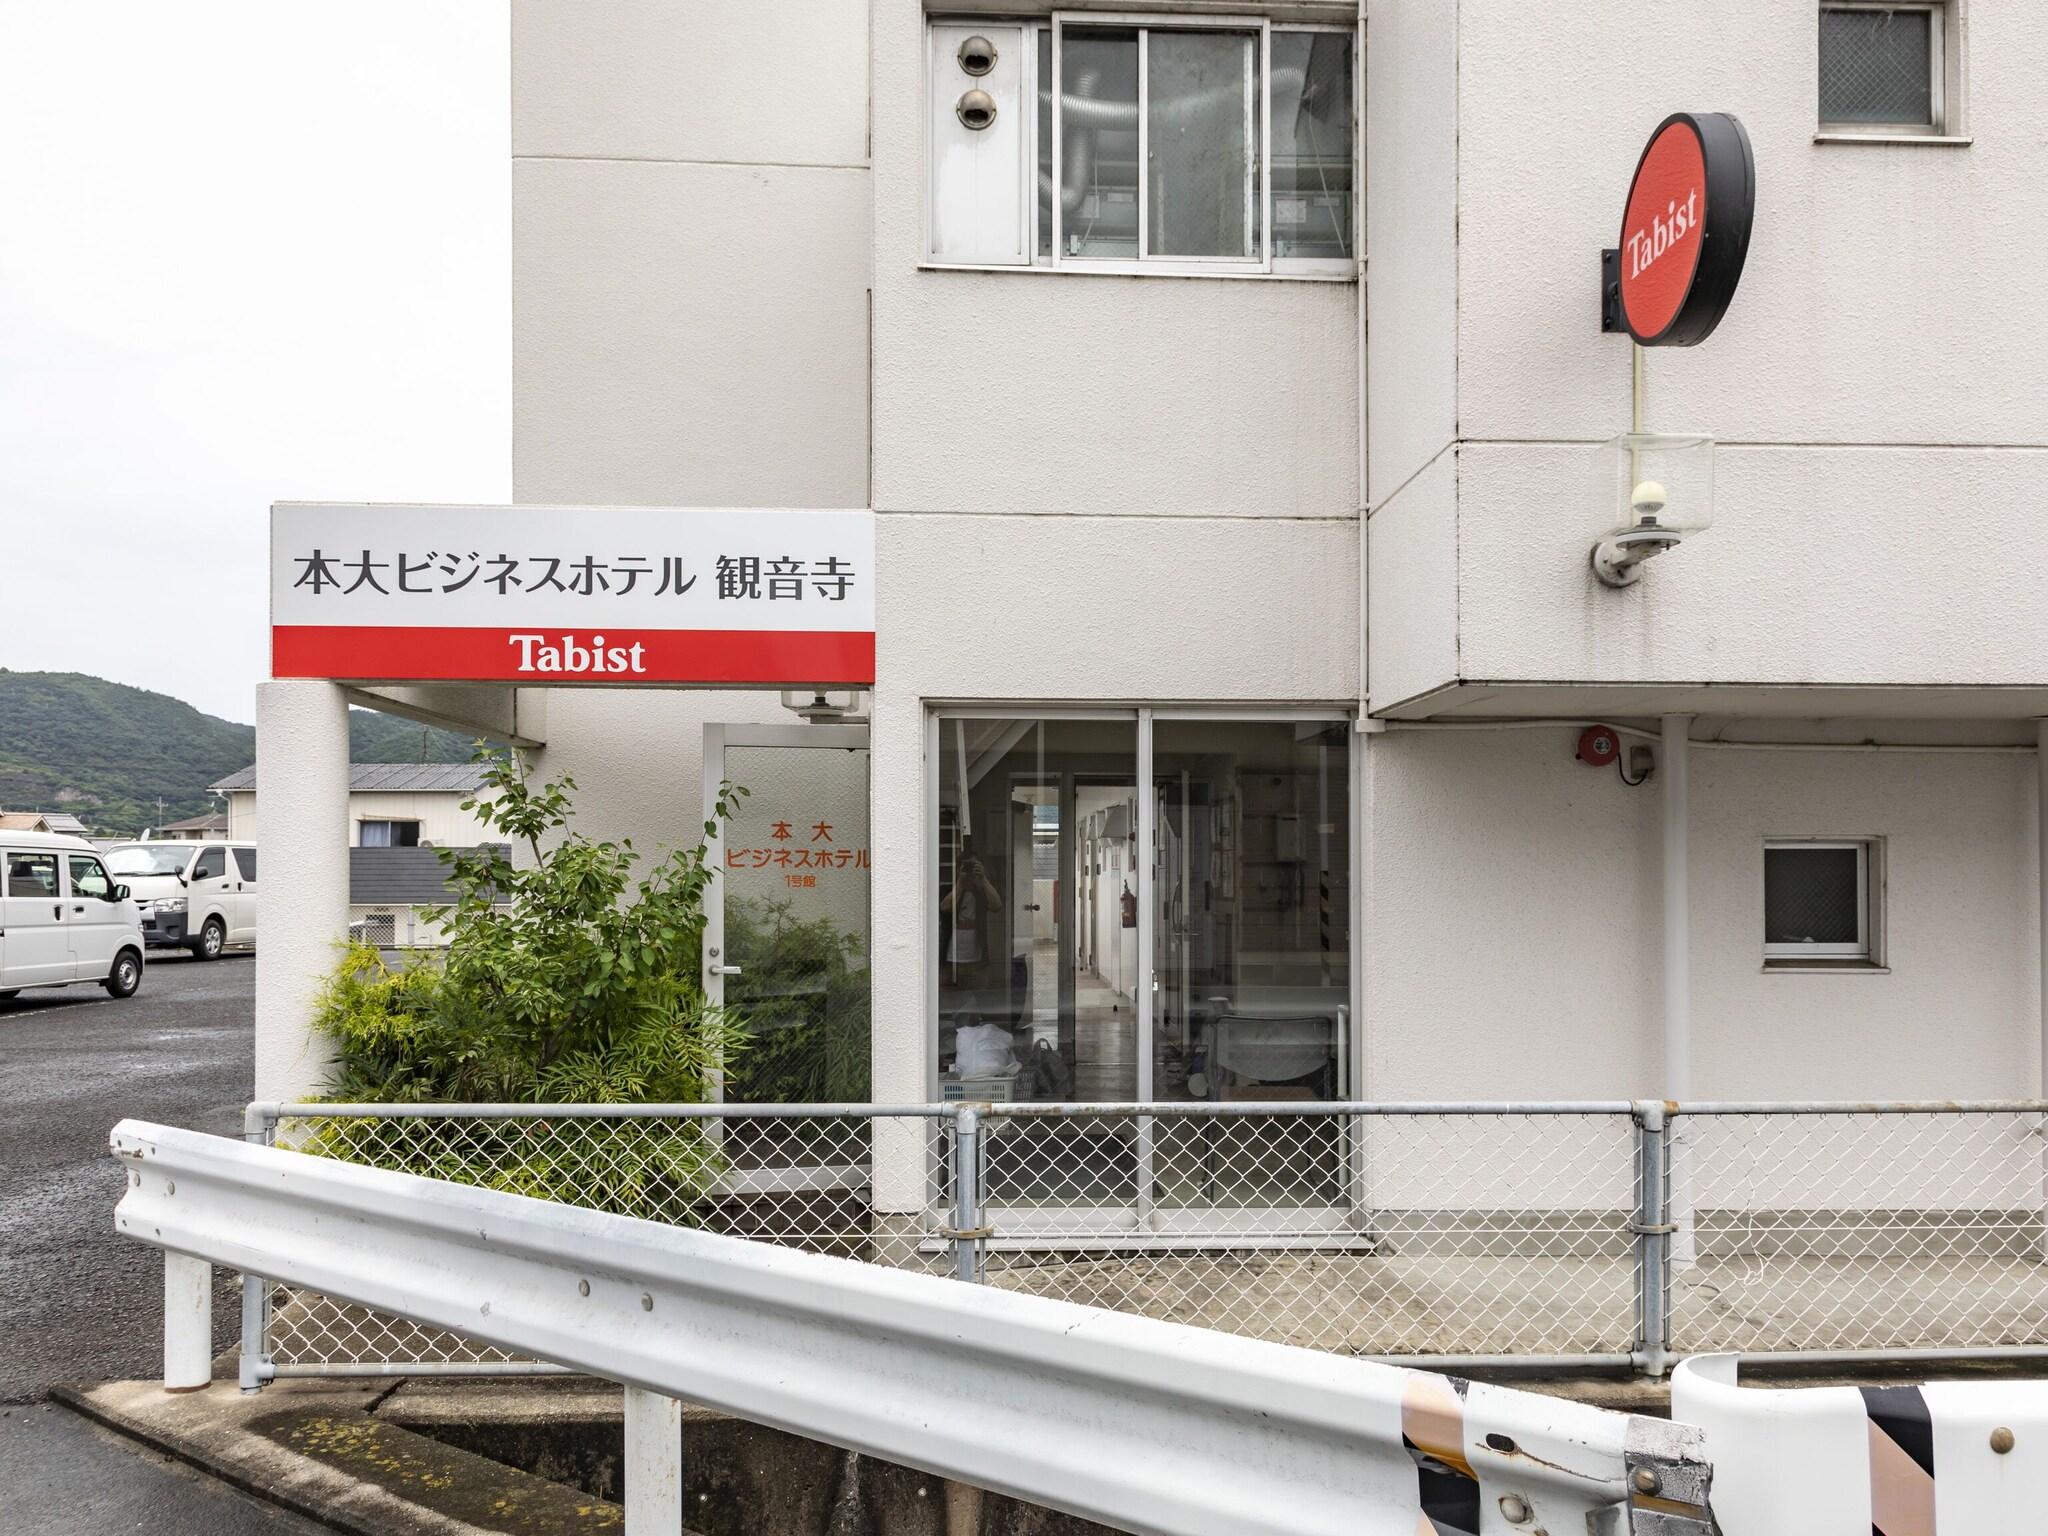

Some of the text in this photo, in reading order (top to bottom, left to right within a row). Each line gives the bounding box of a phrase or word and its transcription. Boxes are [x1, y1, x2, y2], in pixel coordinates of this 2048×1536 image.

[1627, 188, 1697, 280] Tabist
[292, 549, 856, 602] 本大ビジネスホテル 観音寺
[509, 634, 646, 673] Tabist
[727, 849, 871, 868] ビジネスホテル
[785, 875, 816, 888] 1号館
